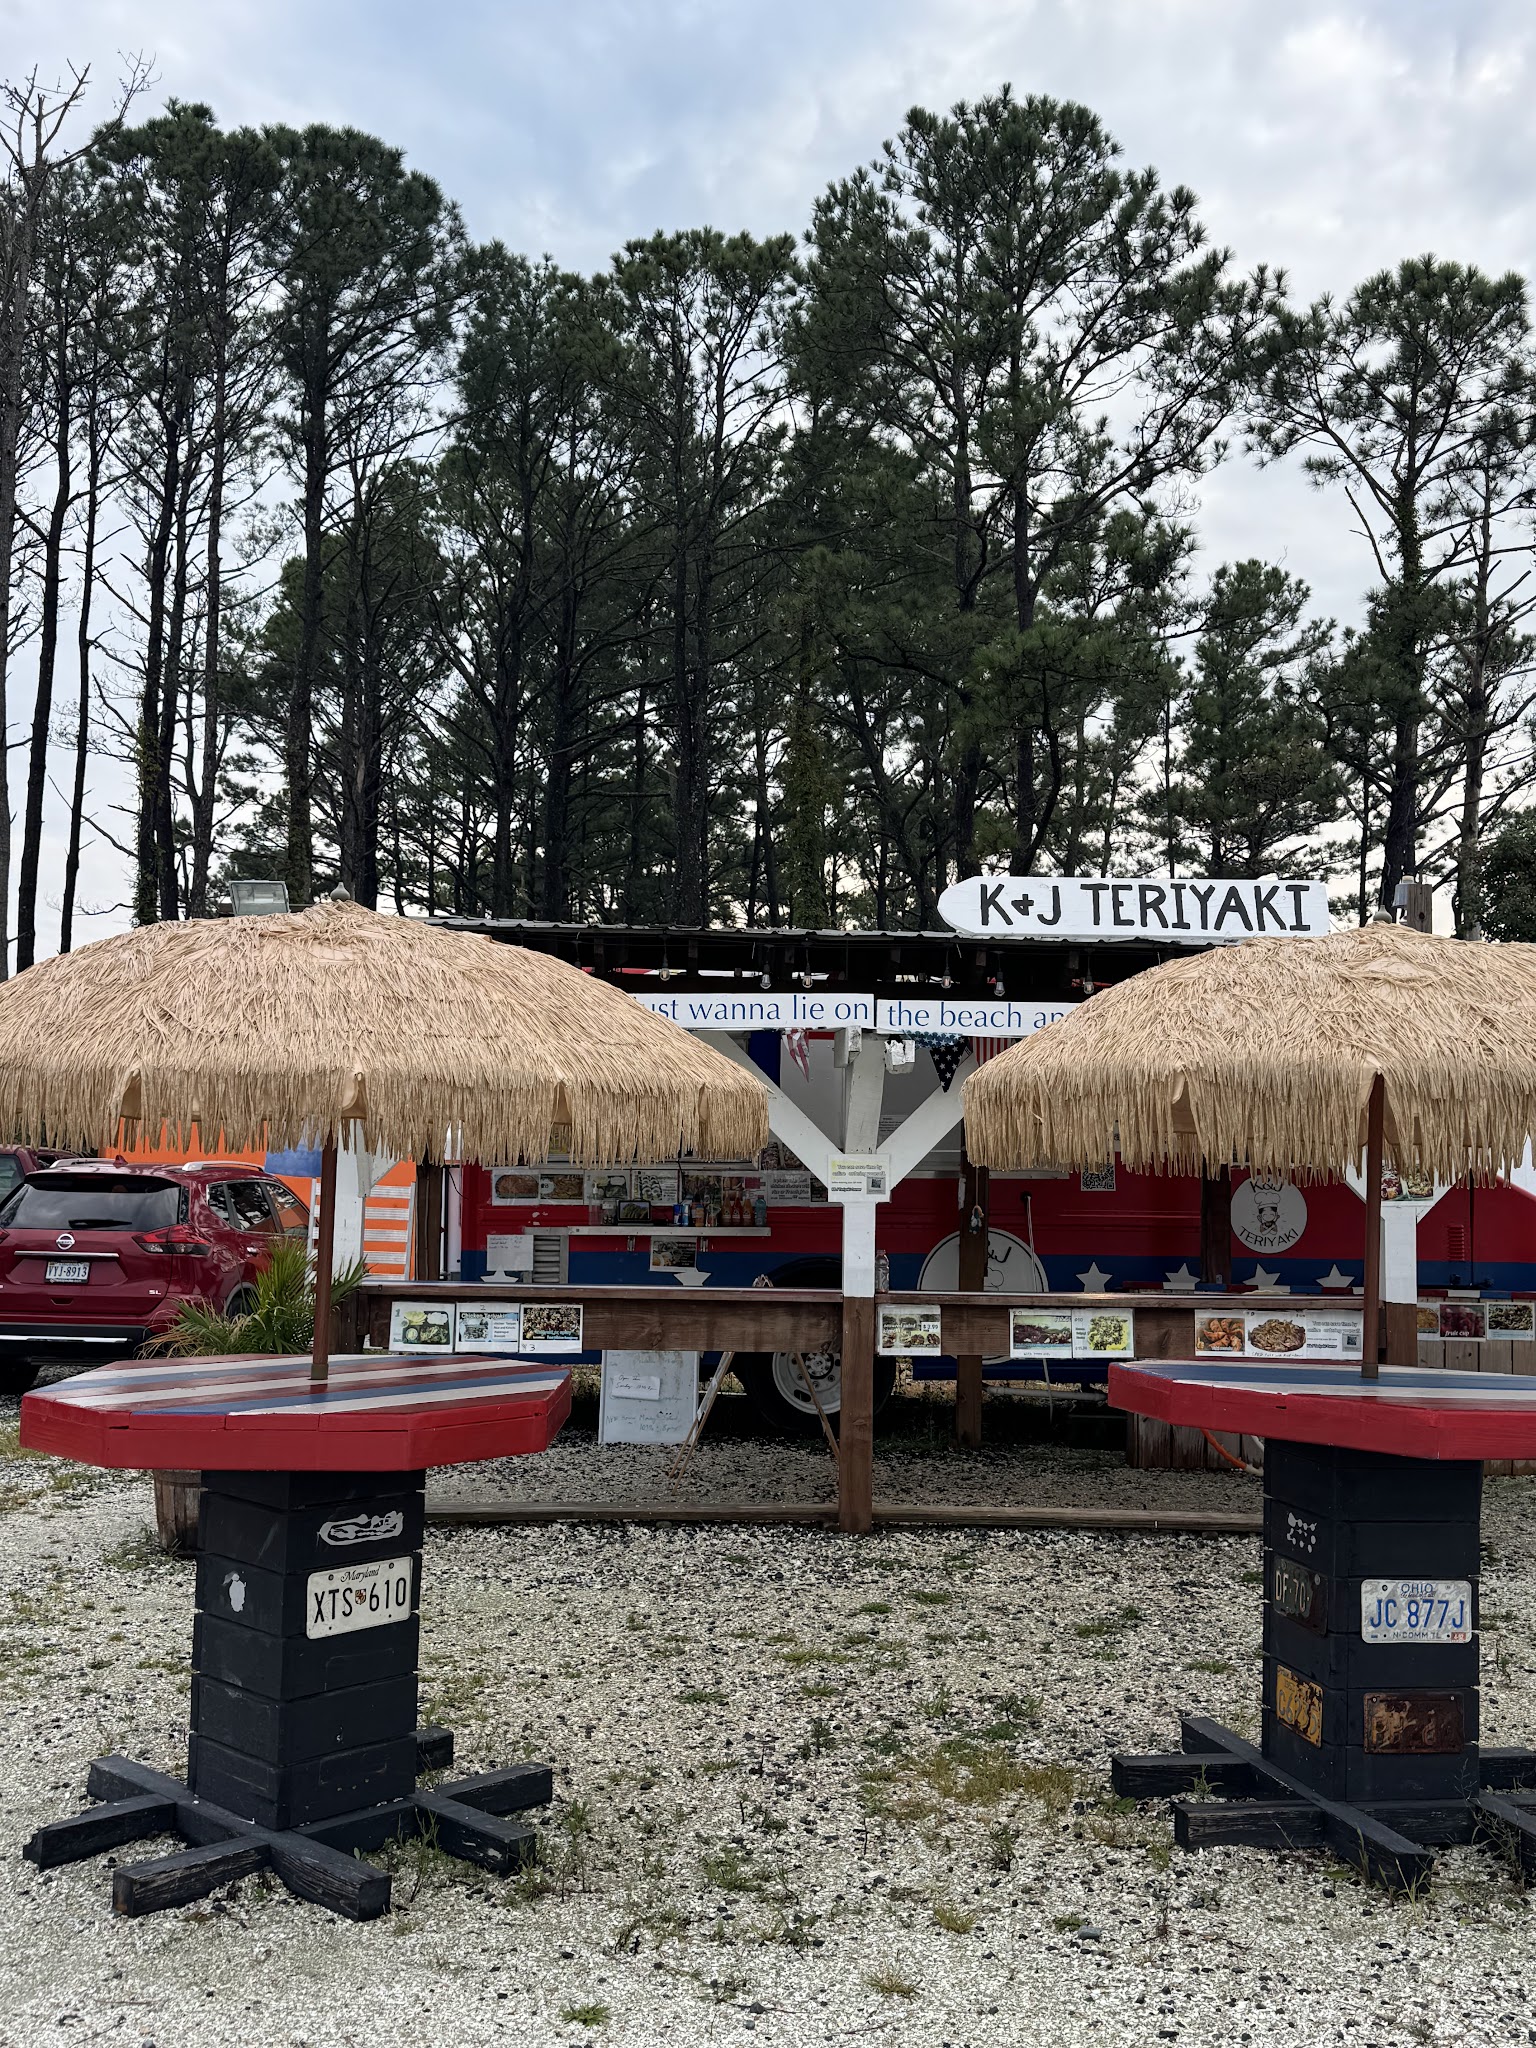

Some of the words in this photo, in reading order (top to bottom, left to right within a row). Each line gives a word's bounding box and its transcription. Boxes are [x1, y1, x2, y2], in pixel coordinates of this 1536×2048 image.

[1080, 883, 1311, 932] TERIYAKI
[689, 1002, 781, 1021] wanna
[793, 994, 825, 1021] lie
[834, 1002, 868, 1021] on
[887, 1000, 930, 1027] the
[940, 1001, 1022, 1028] beach
[1240, 1226, 1299, 1247] TERIYAKI
[340, 1565, 381, 1583] Maryland
[314, 1587, 353, 1624] XTS
[369, 1577, 406, 1612] 610
[1401, 1583, 1434, 1594] OHIO
[1369, 1599, 1398, 1629] JC
[1407, 1598, 1465, 1629] 877J
